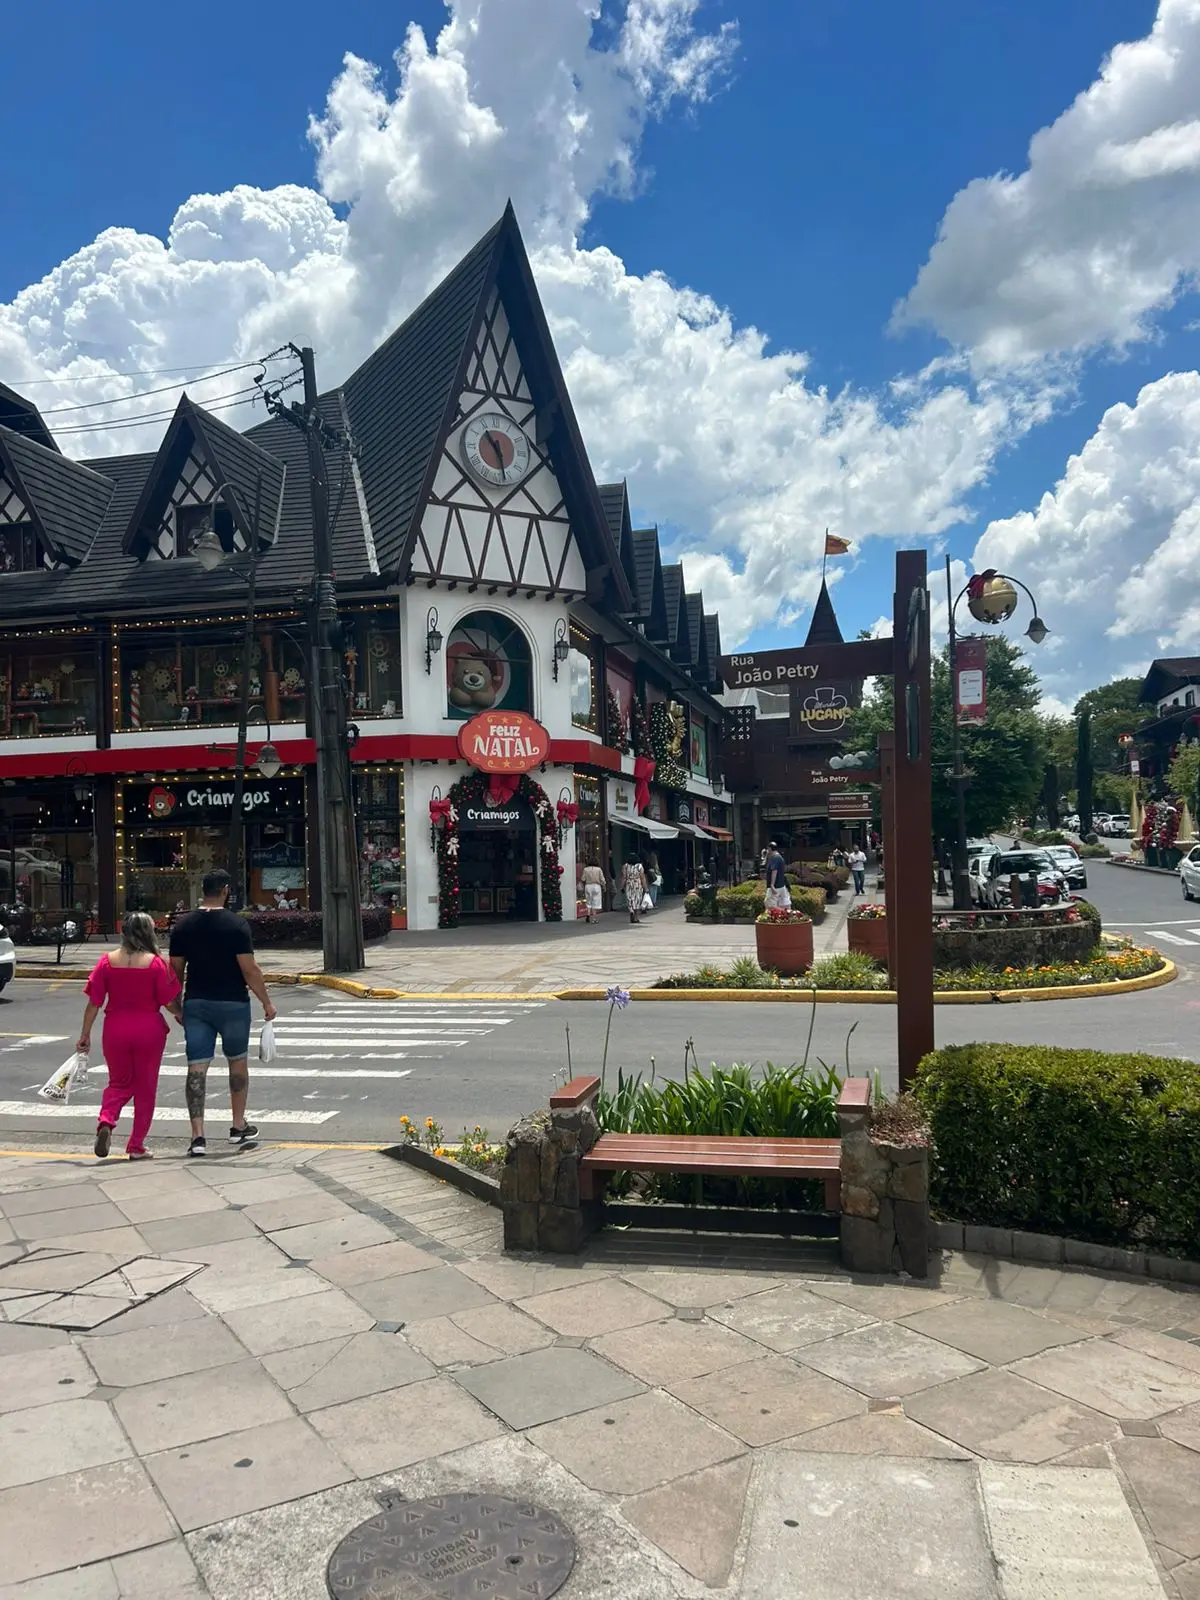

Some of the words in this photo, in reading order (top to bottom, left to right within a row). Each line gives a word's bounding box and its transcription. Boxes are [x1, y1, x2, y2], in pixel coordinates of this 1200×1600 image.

[730, 655, 755, 667] Rua
[735, 667, 773, 685] João
[776, 663, 820, 681] Petry
[800, 707, 852, 722] LUGANO
[473, 735, 540, 757] NATAL
[811, 776, 829, 784] João
[829, 775, 848, 783] Petry
[187, 787, 271, 811] Criamgos
[467, 808, 520, 824] Criamigos
